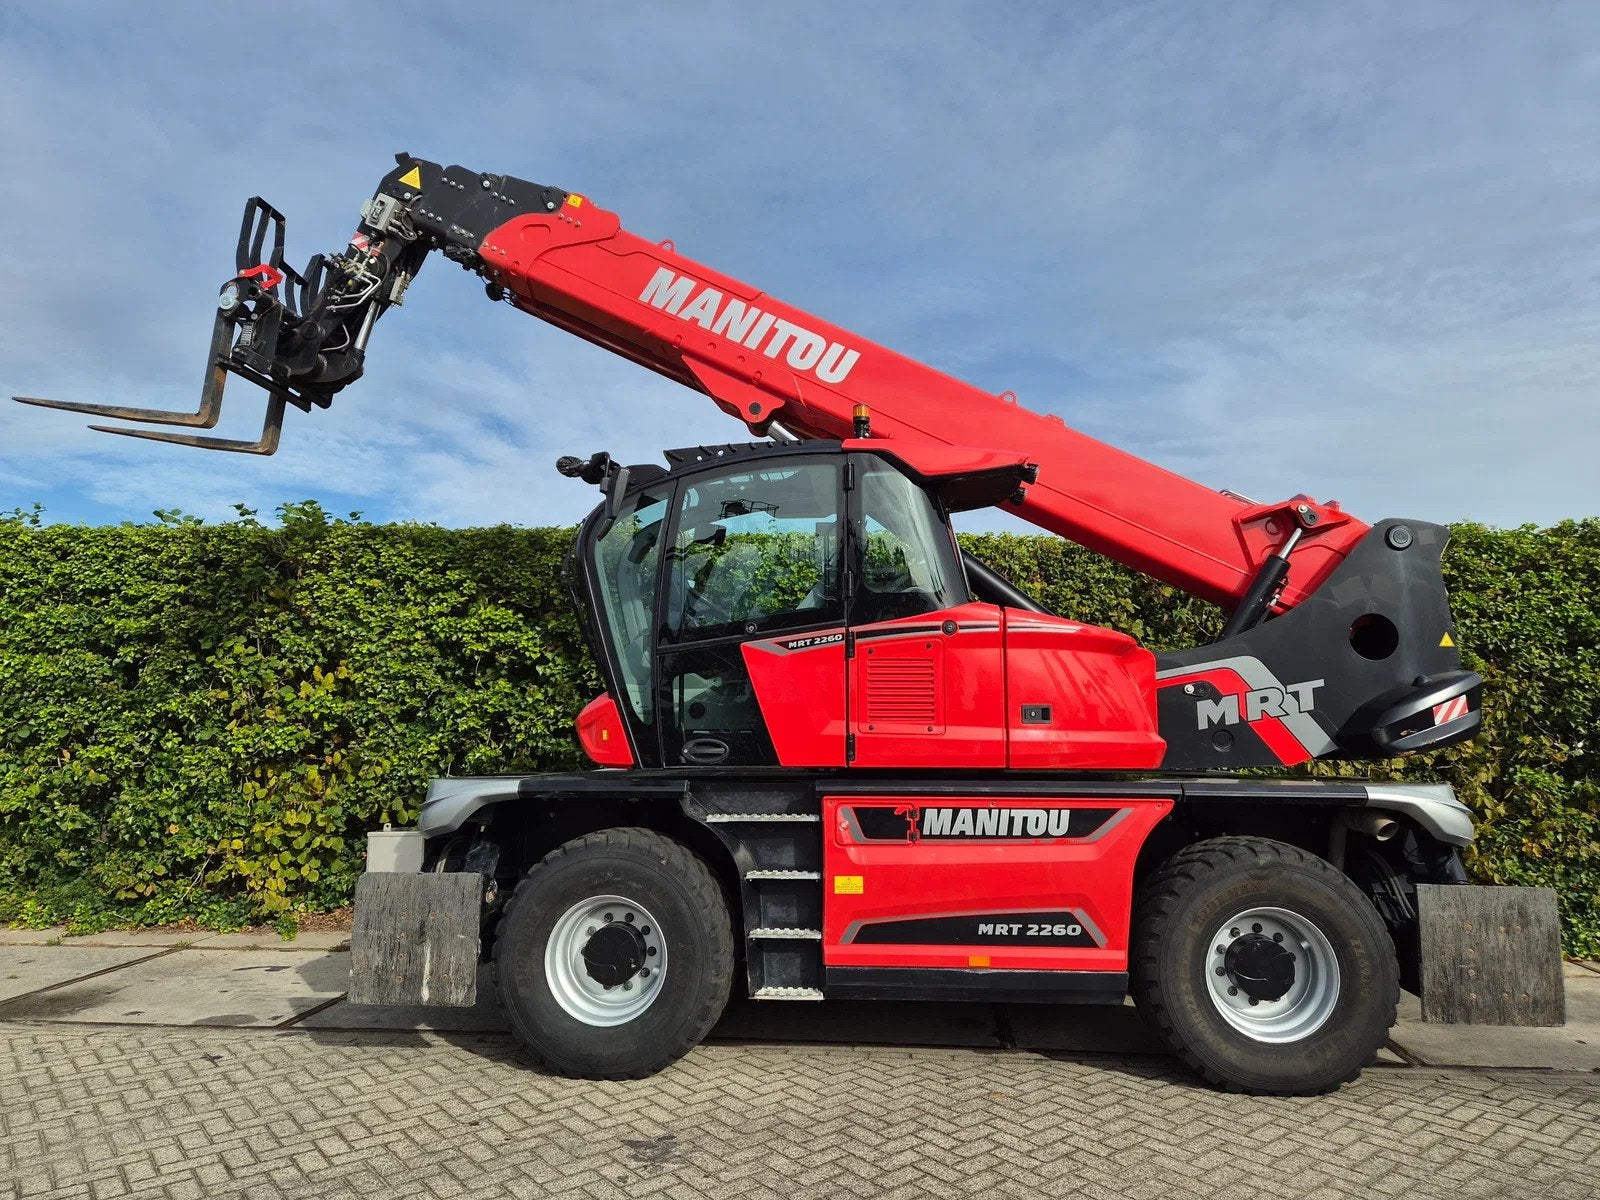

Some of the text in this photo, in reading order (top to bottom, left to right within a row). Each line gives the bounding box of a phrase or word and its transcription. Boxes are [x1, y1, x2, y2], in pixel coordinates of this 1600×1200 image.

[638, 266, 862, 384] MANITOU
[788, 634, 843, 649] MRT 2260
[1196, 678, 1325, 731] MRT
[922, 808, 1071, 837] MANITOU
[977, 923, 1082, 937] MRT 2260
